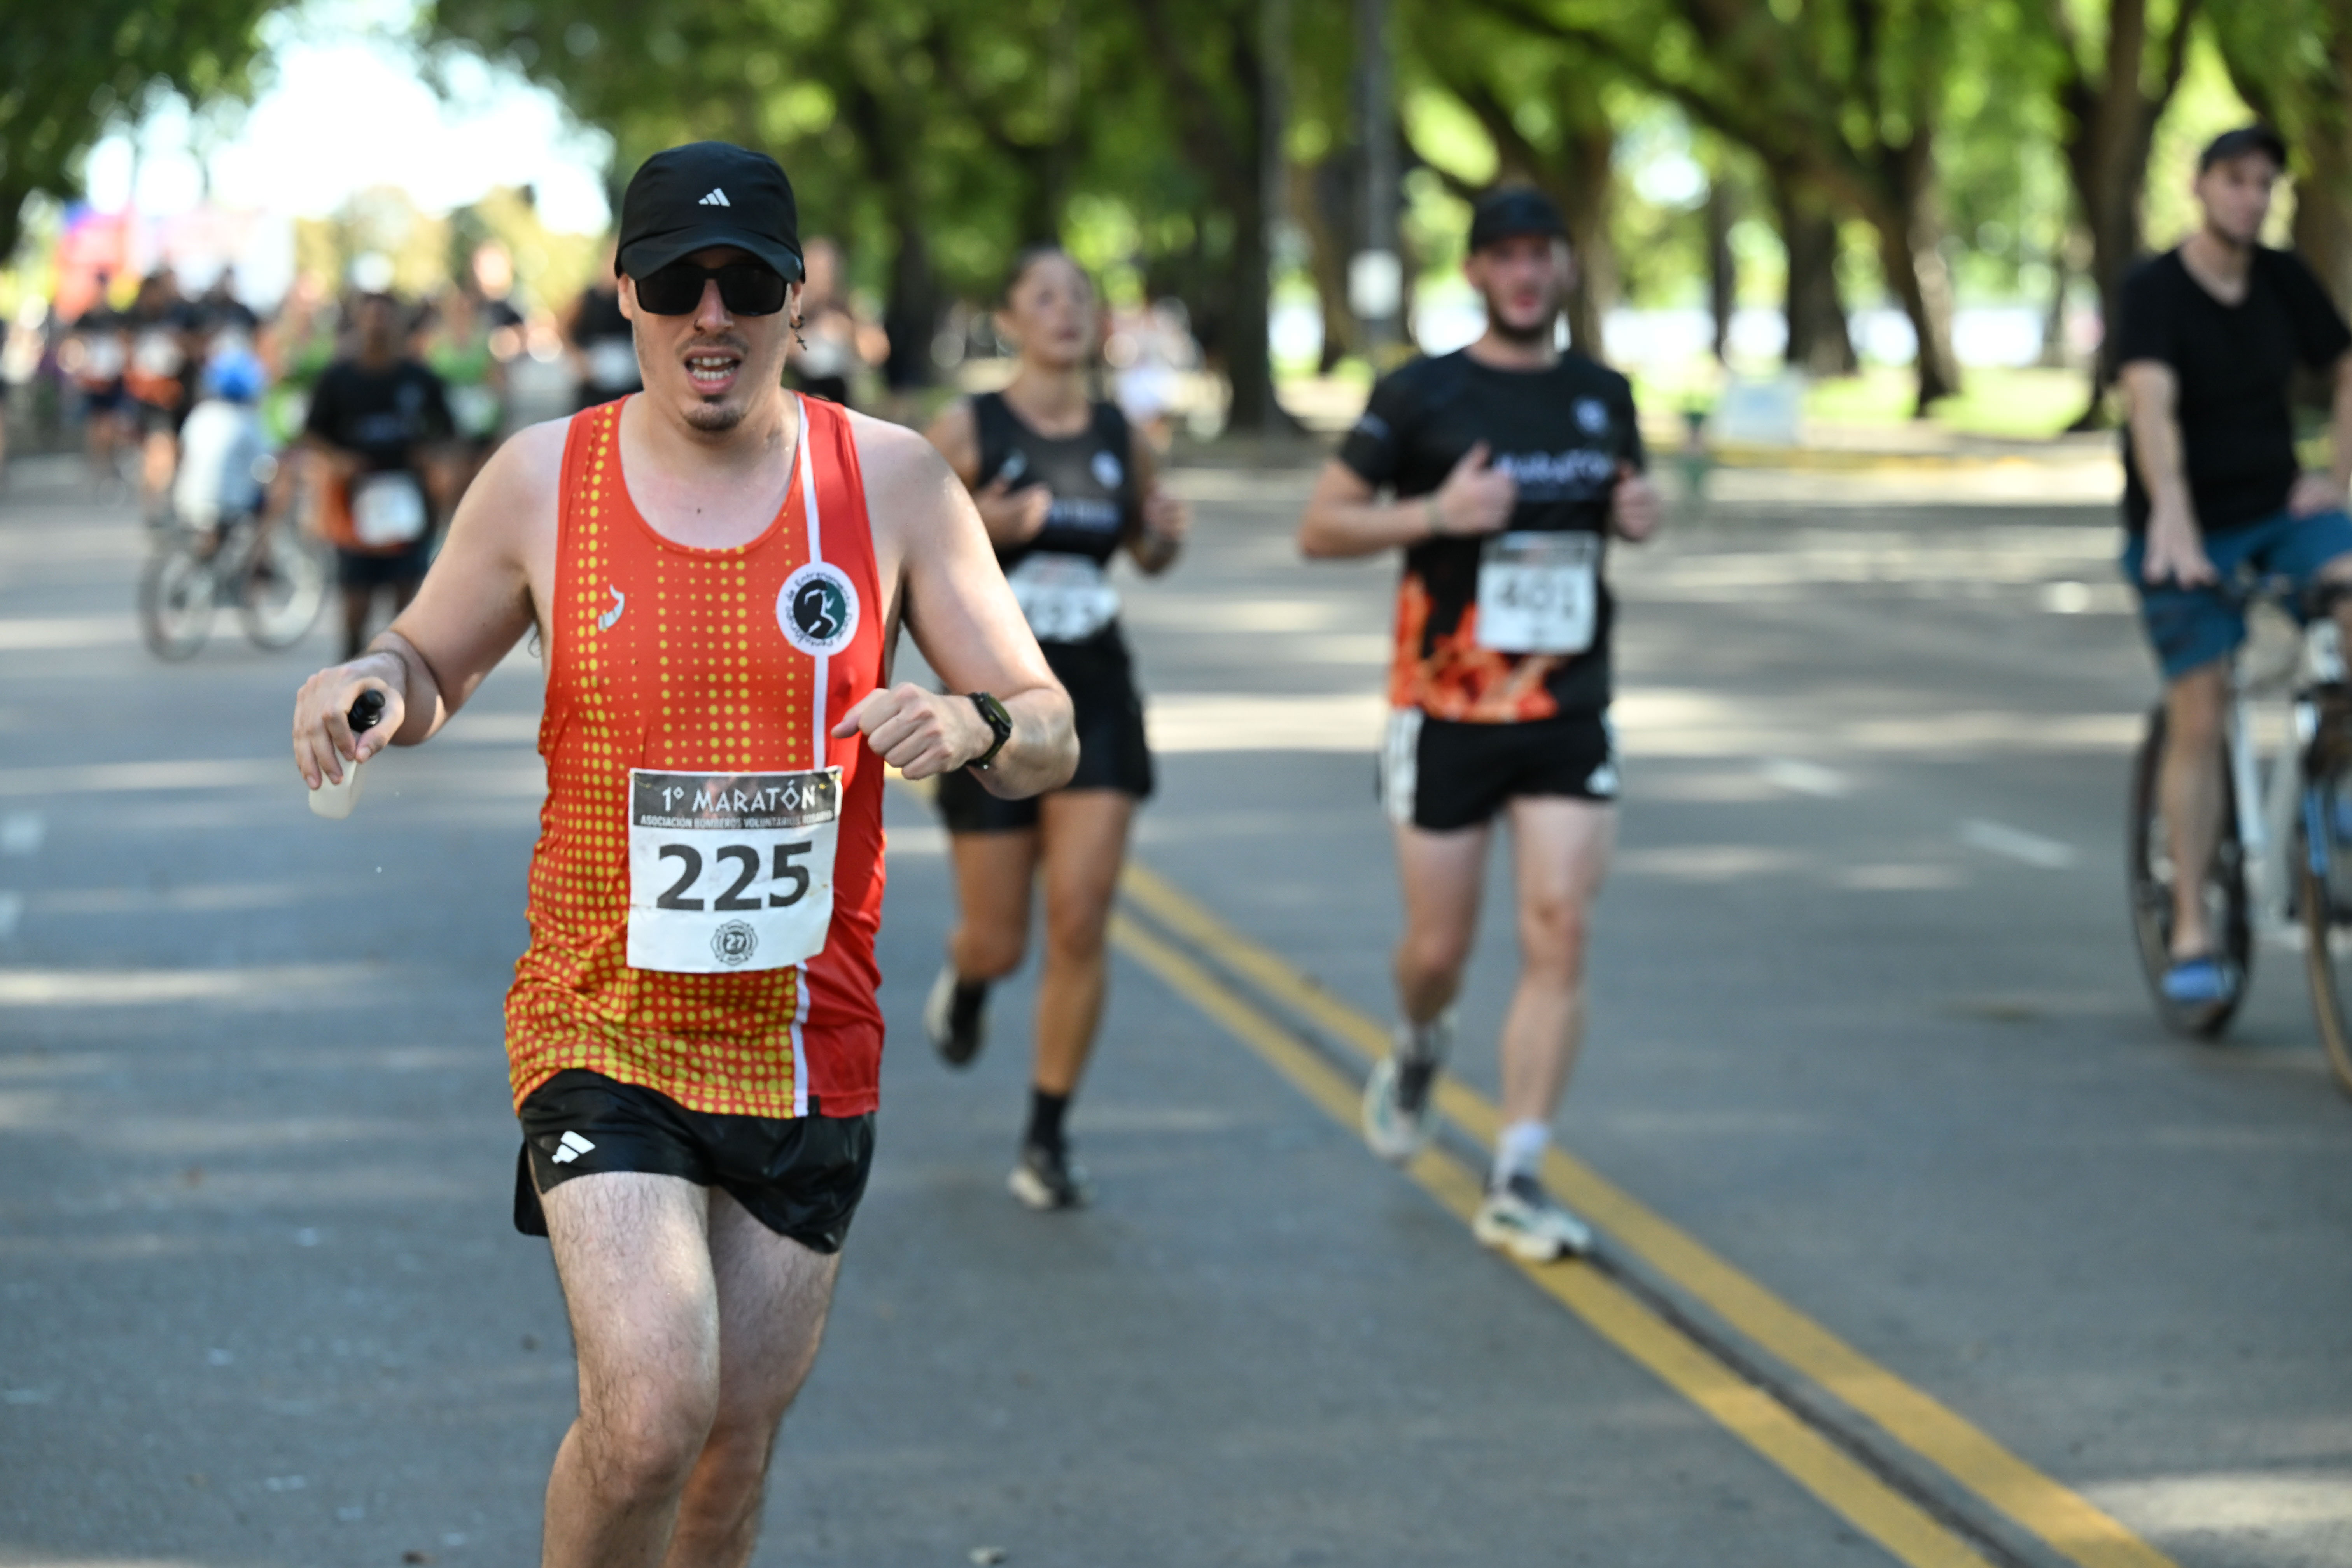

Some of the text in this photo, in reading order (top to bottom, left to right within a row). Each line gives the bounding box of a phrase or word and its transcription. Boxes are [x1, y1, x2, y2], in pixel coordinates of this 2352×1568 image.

[692, 779, 816, 812] MARATÓN
[656, 840, 812, 910] 225
[726, 933, 745, 950] 27
